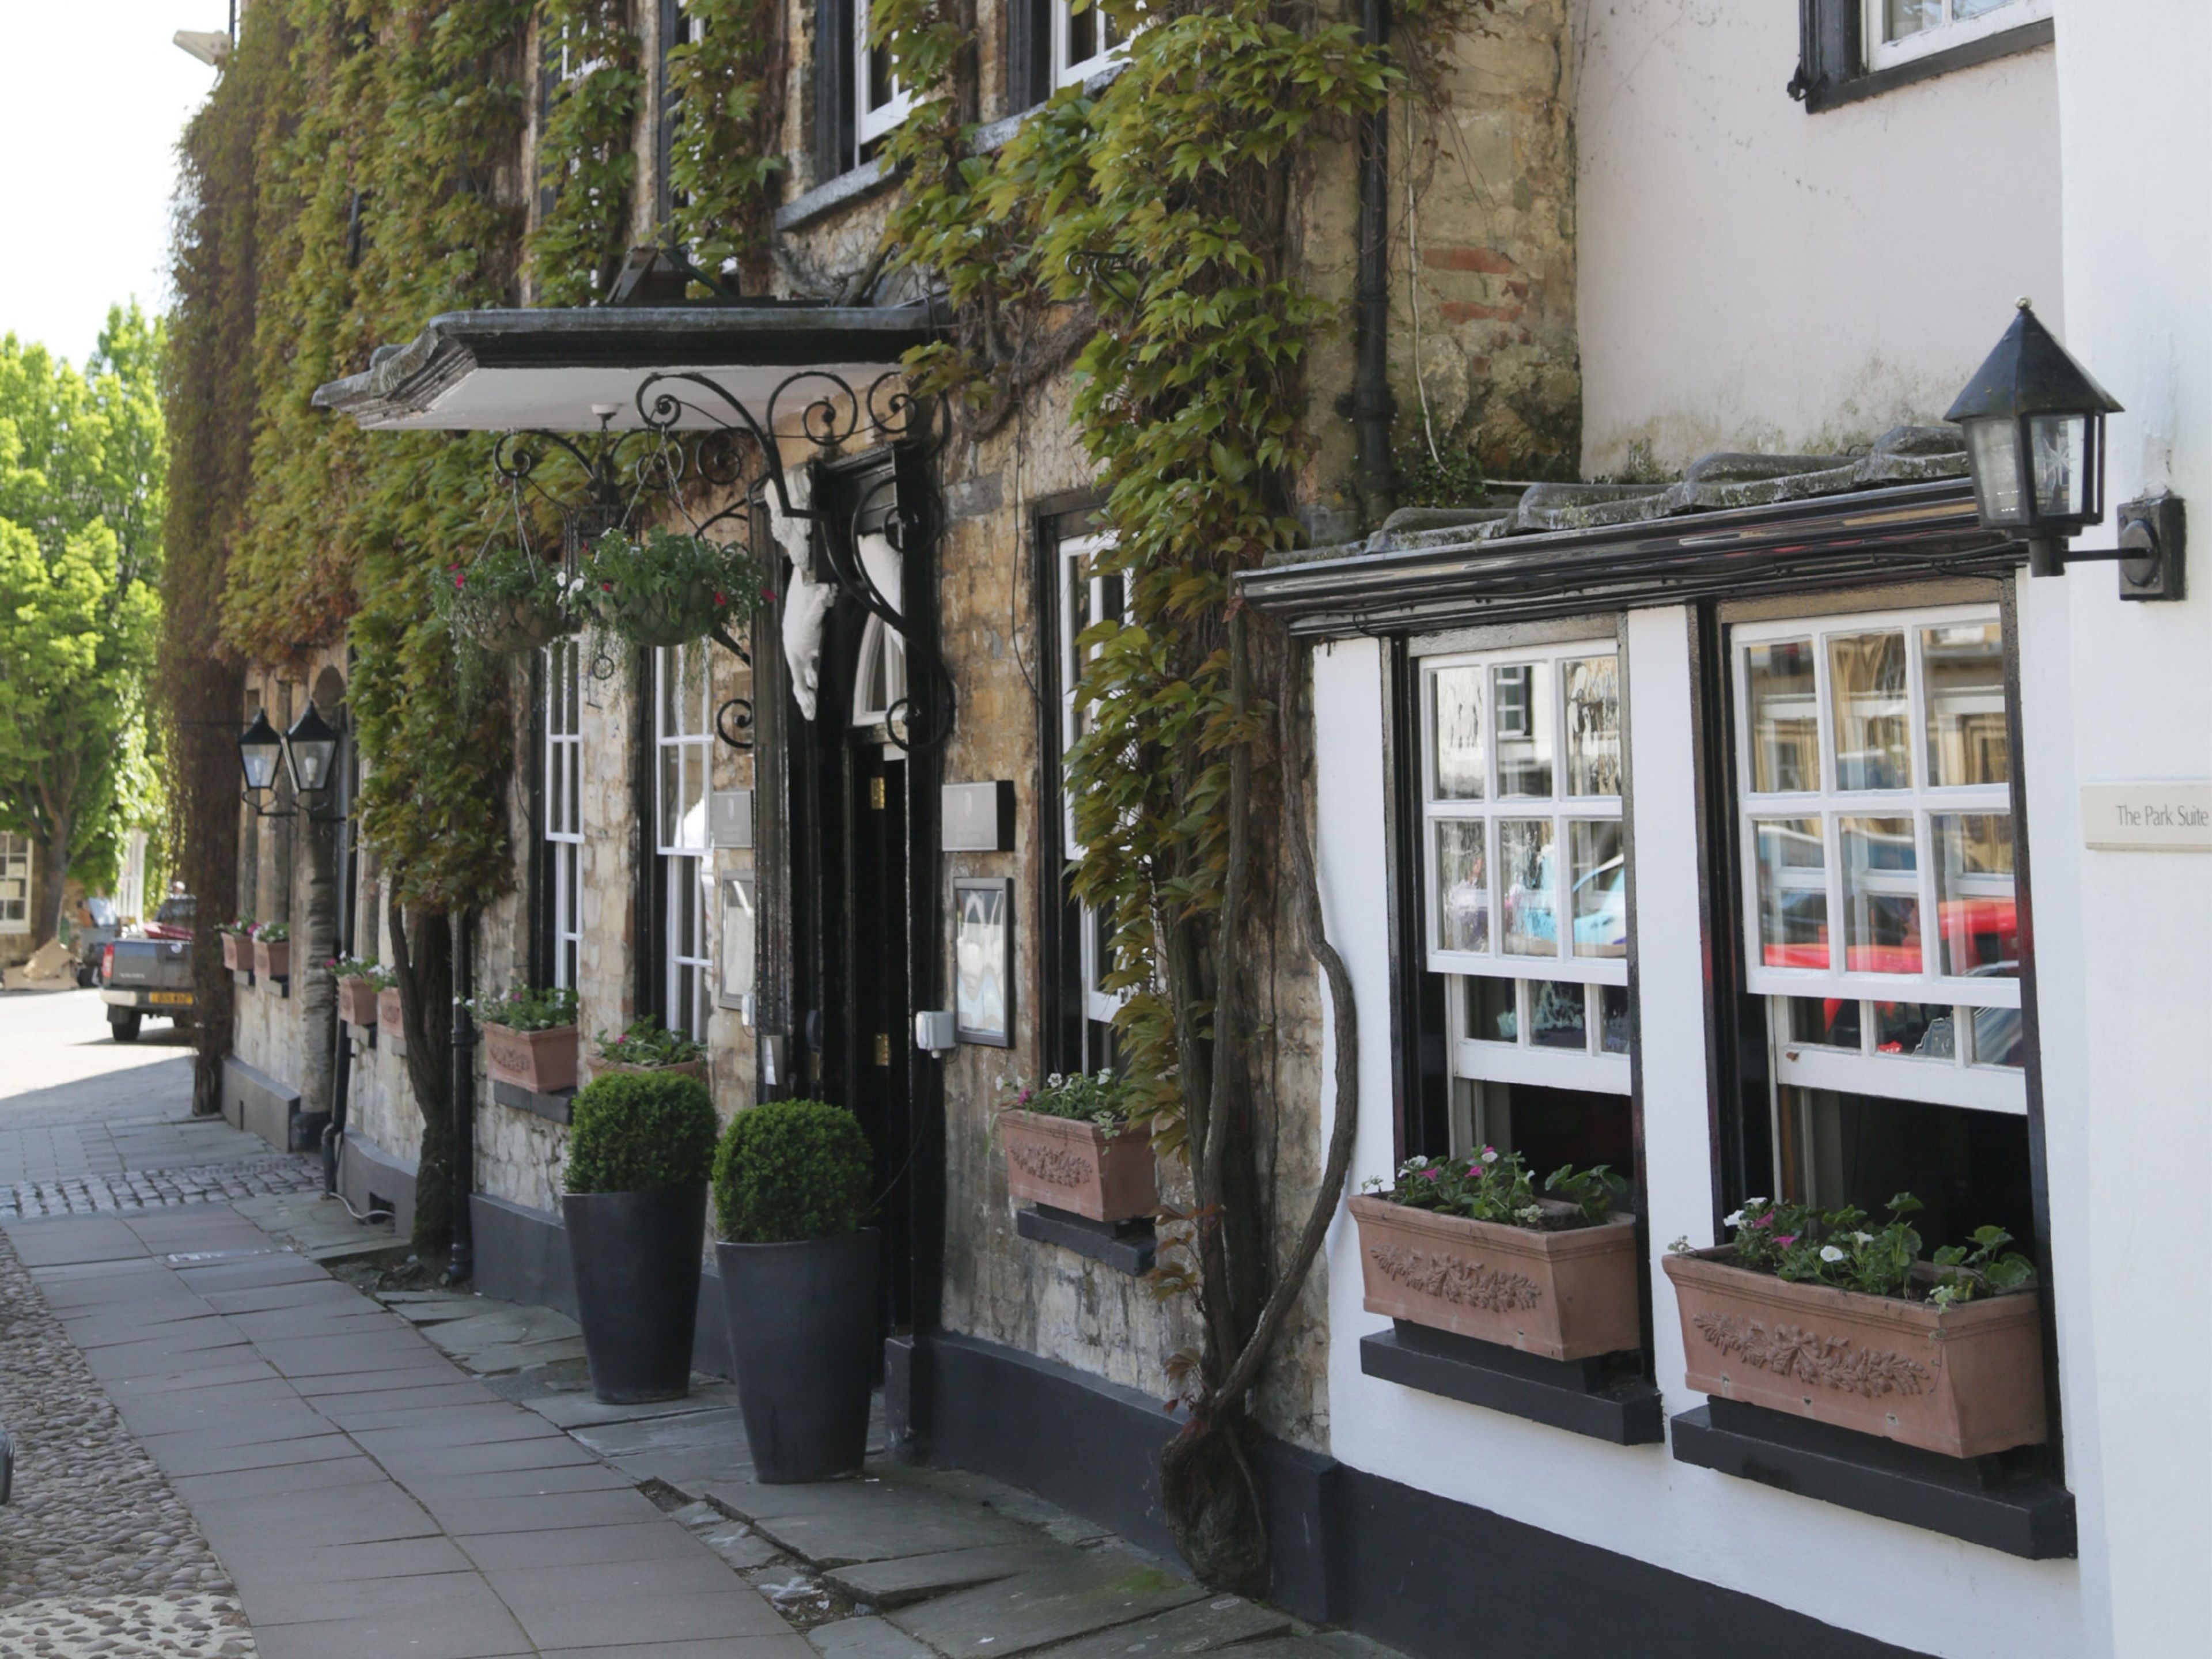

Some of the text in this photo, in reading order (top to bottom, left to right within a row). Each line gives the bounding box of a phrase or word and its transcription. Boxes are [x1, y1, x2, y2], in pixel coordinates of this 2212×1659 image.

[2116, 804, 2209, 827] The Park Suite
